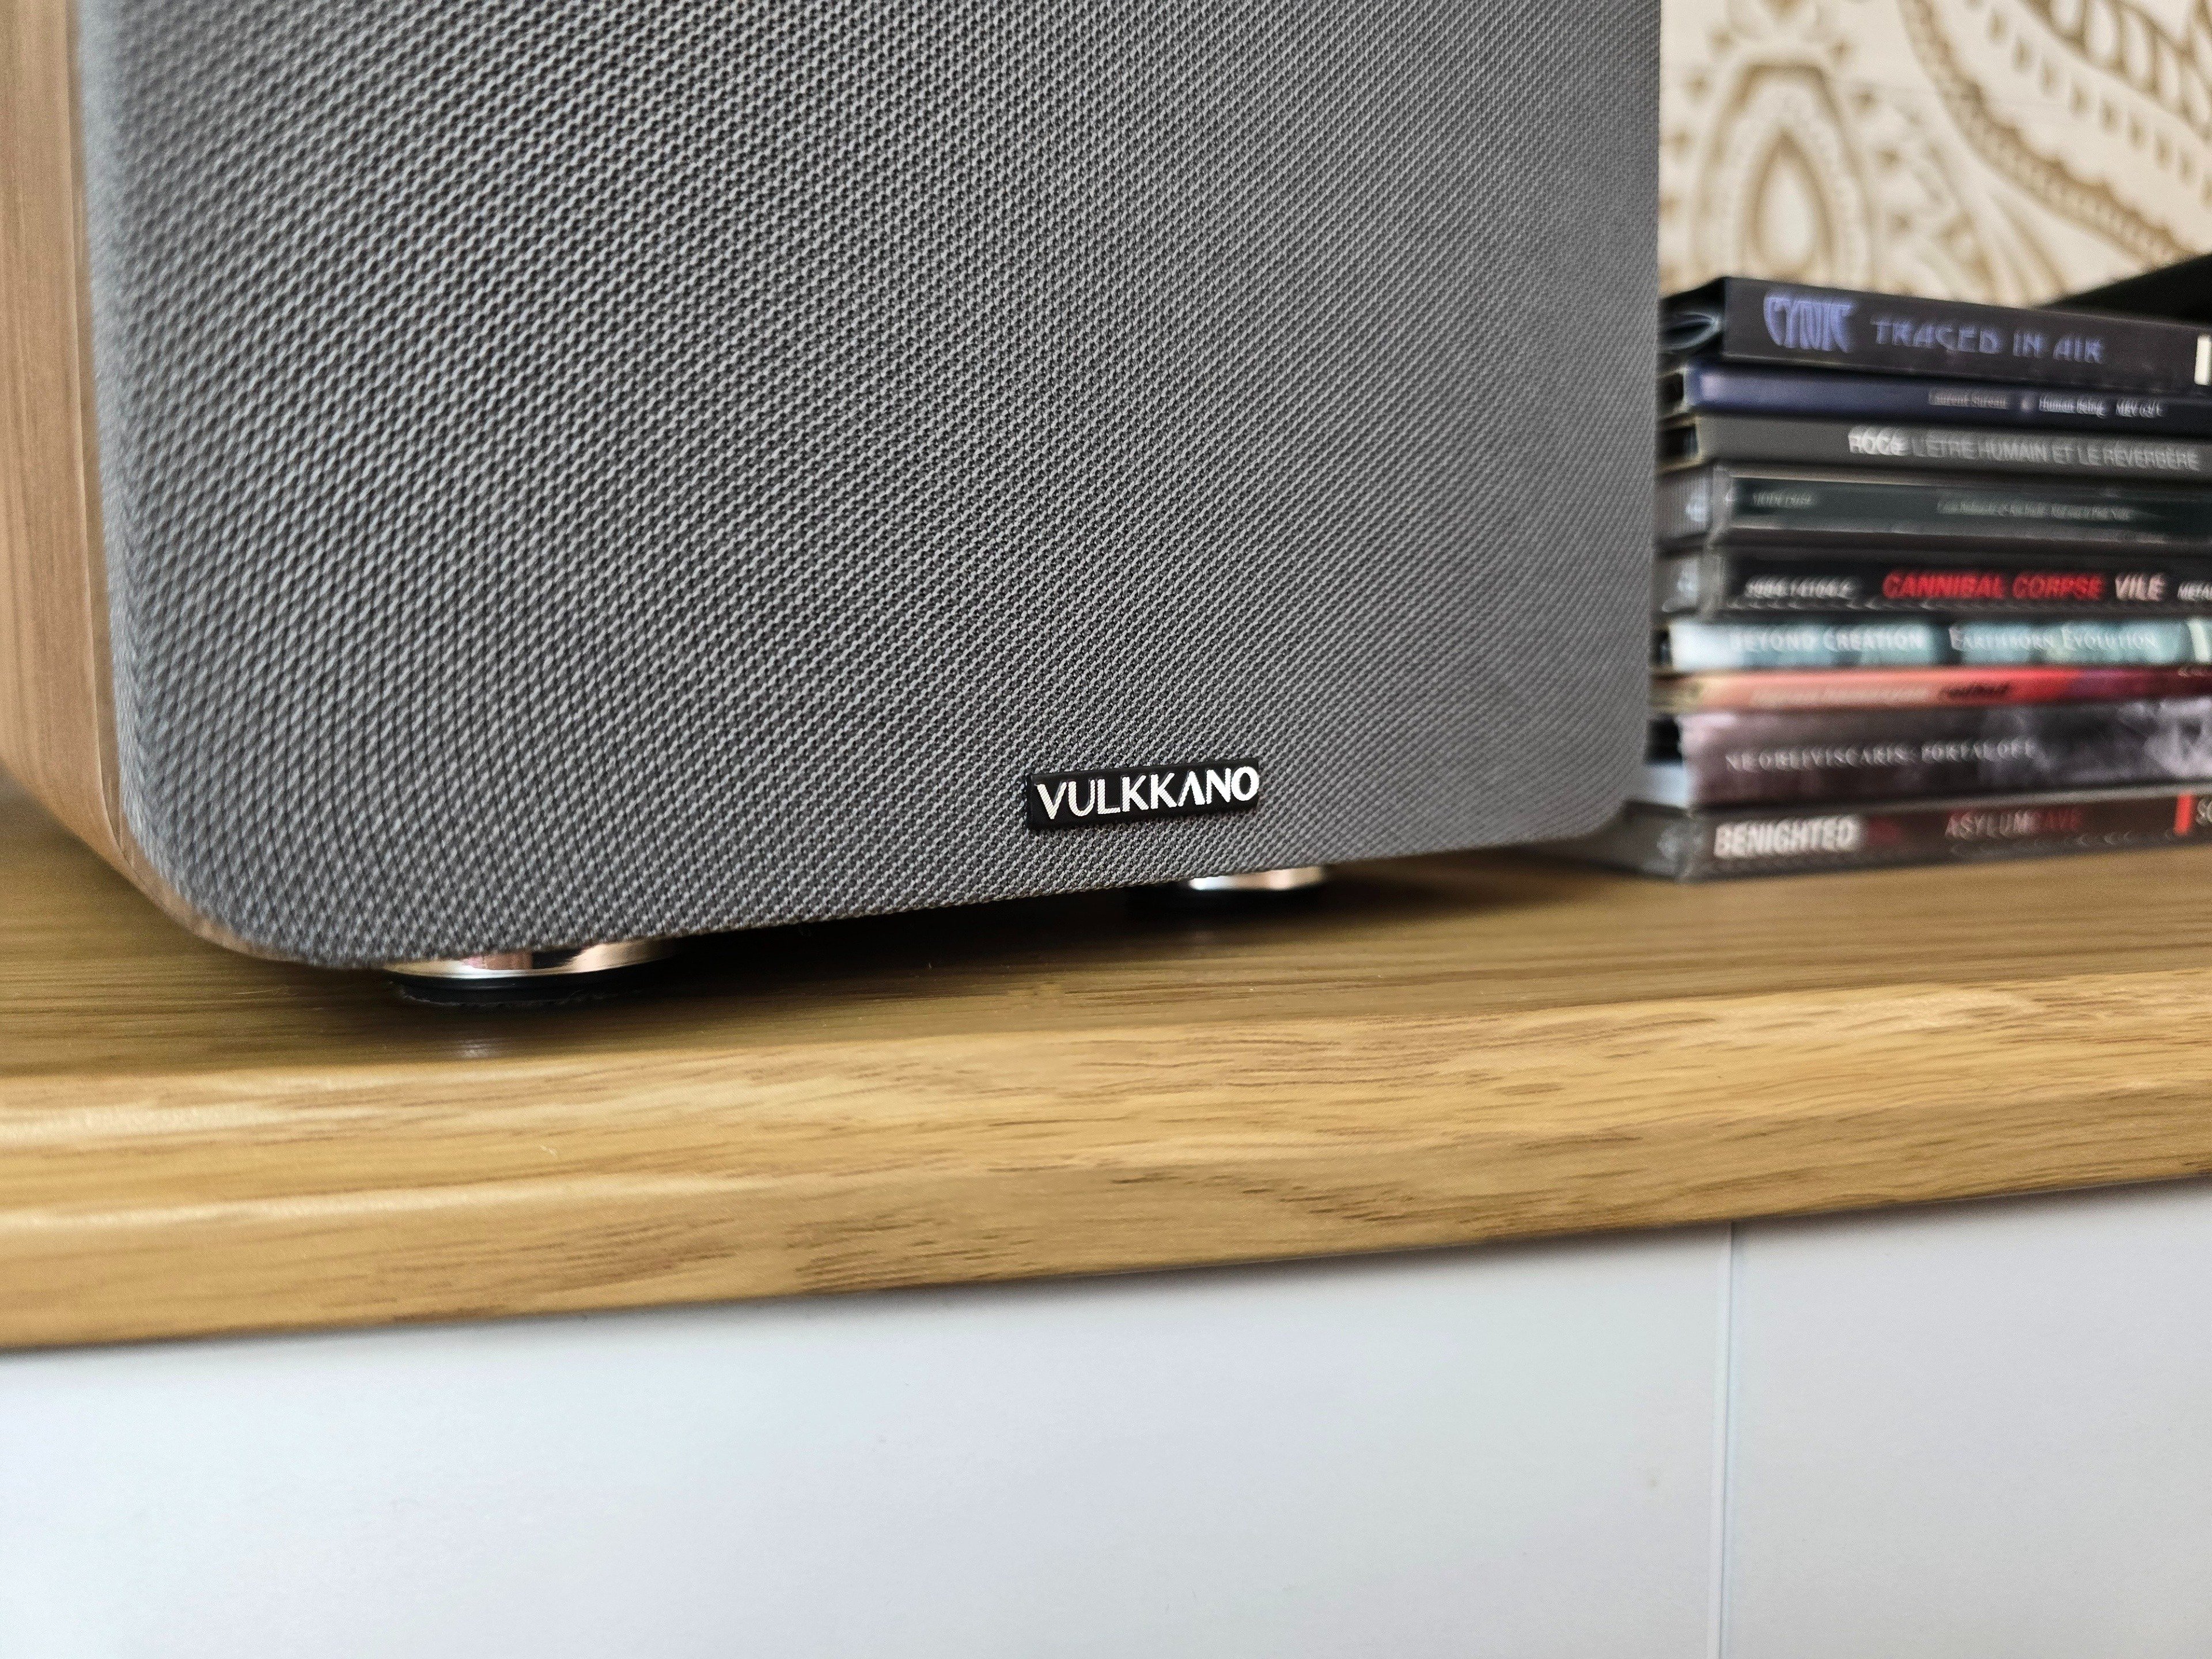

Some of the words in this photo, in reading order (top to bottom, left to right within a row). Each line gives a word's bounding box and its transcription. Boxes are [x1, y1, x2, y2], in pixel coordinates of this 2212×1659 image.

[1872, 318, 2002, 354] TRACED
[2013, 331, 2043, 358] IN
[2052, 336, 2103, 364] AIR
[1978, 439, 2047, 463] HUMAIN
[2051, 444, 2074, 465] ET
[2077, 446, 2101, 467] LE
[1883, 571, 2004, 599] CANNIBAL
[2012, 572, 2104, 600] CORPSE
[2115, 573, 2165, 601] VILE
[1823, 627, 1926, 652] CREATION
[1037, 766, 1260, 820] VULKKANO
[1714, 816, 1861, 858] BENIGHTED
